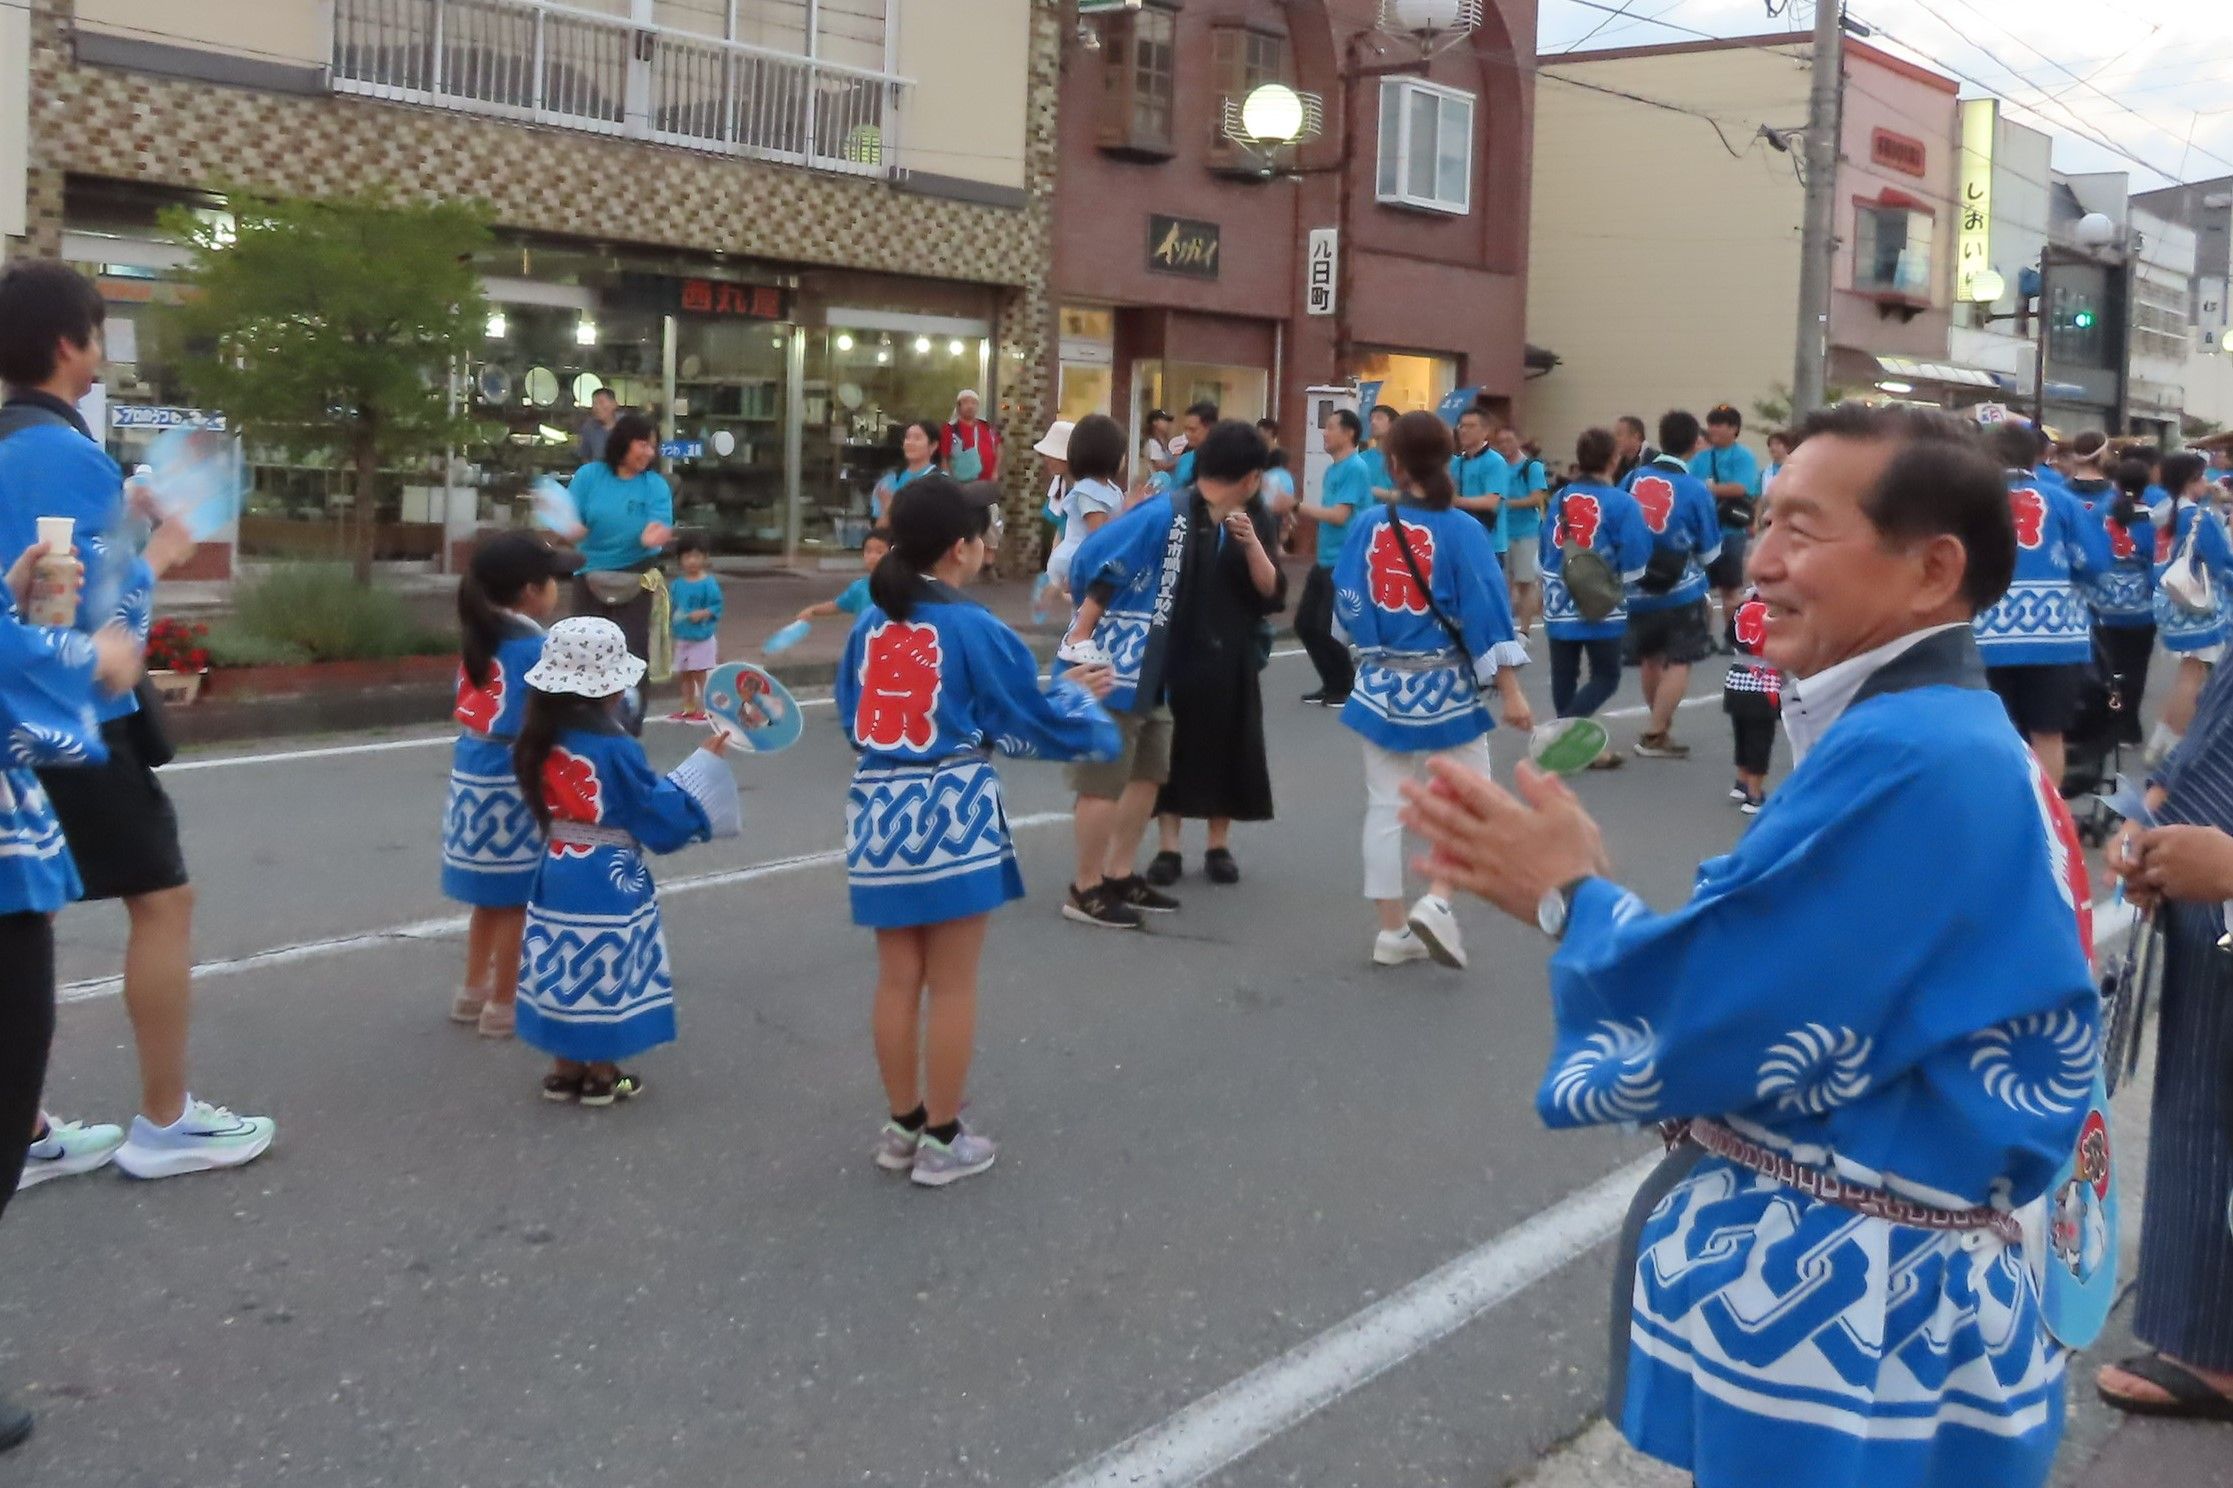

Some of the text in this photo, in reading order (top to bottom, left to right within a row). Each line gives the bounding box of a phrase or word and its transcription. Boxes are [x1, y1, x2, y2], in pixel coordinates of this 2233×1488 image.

[1311, 240, 1332, 311] 八日町
[855, 621, 942, 753] 祭
